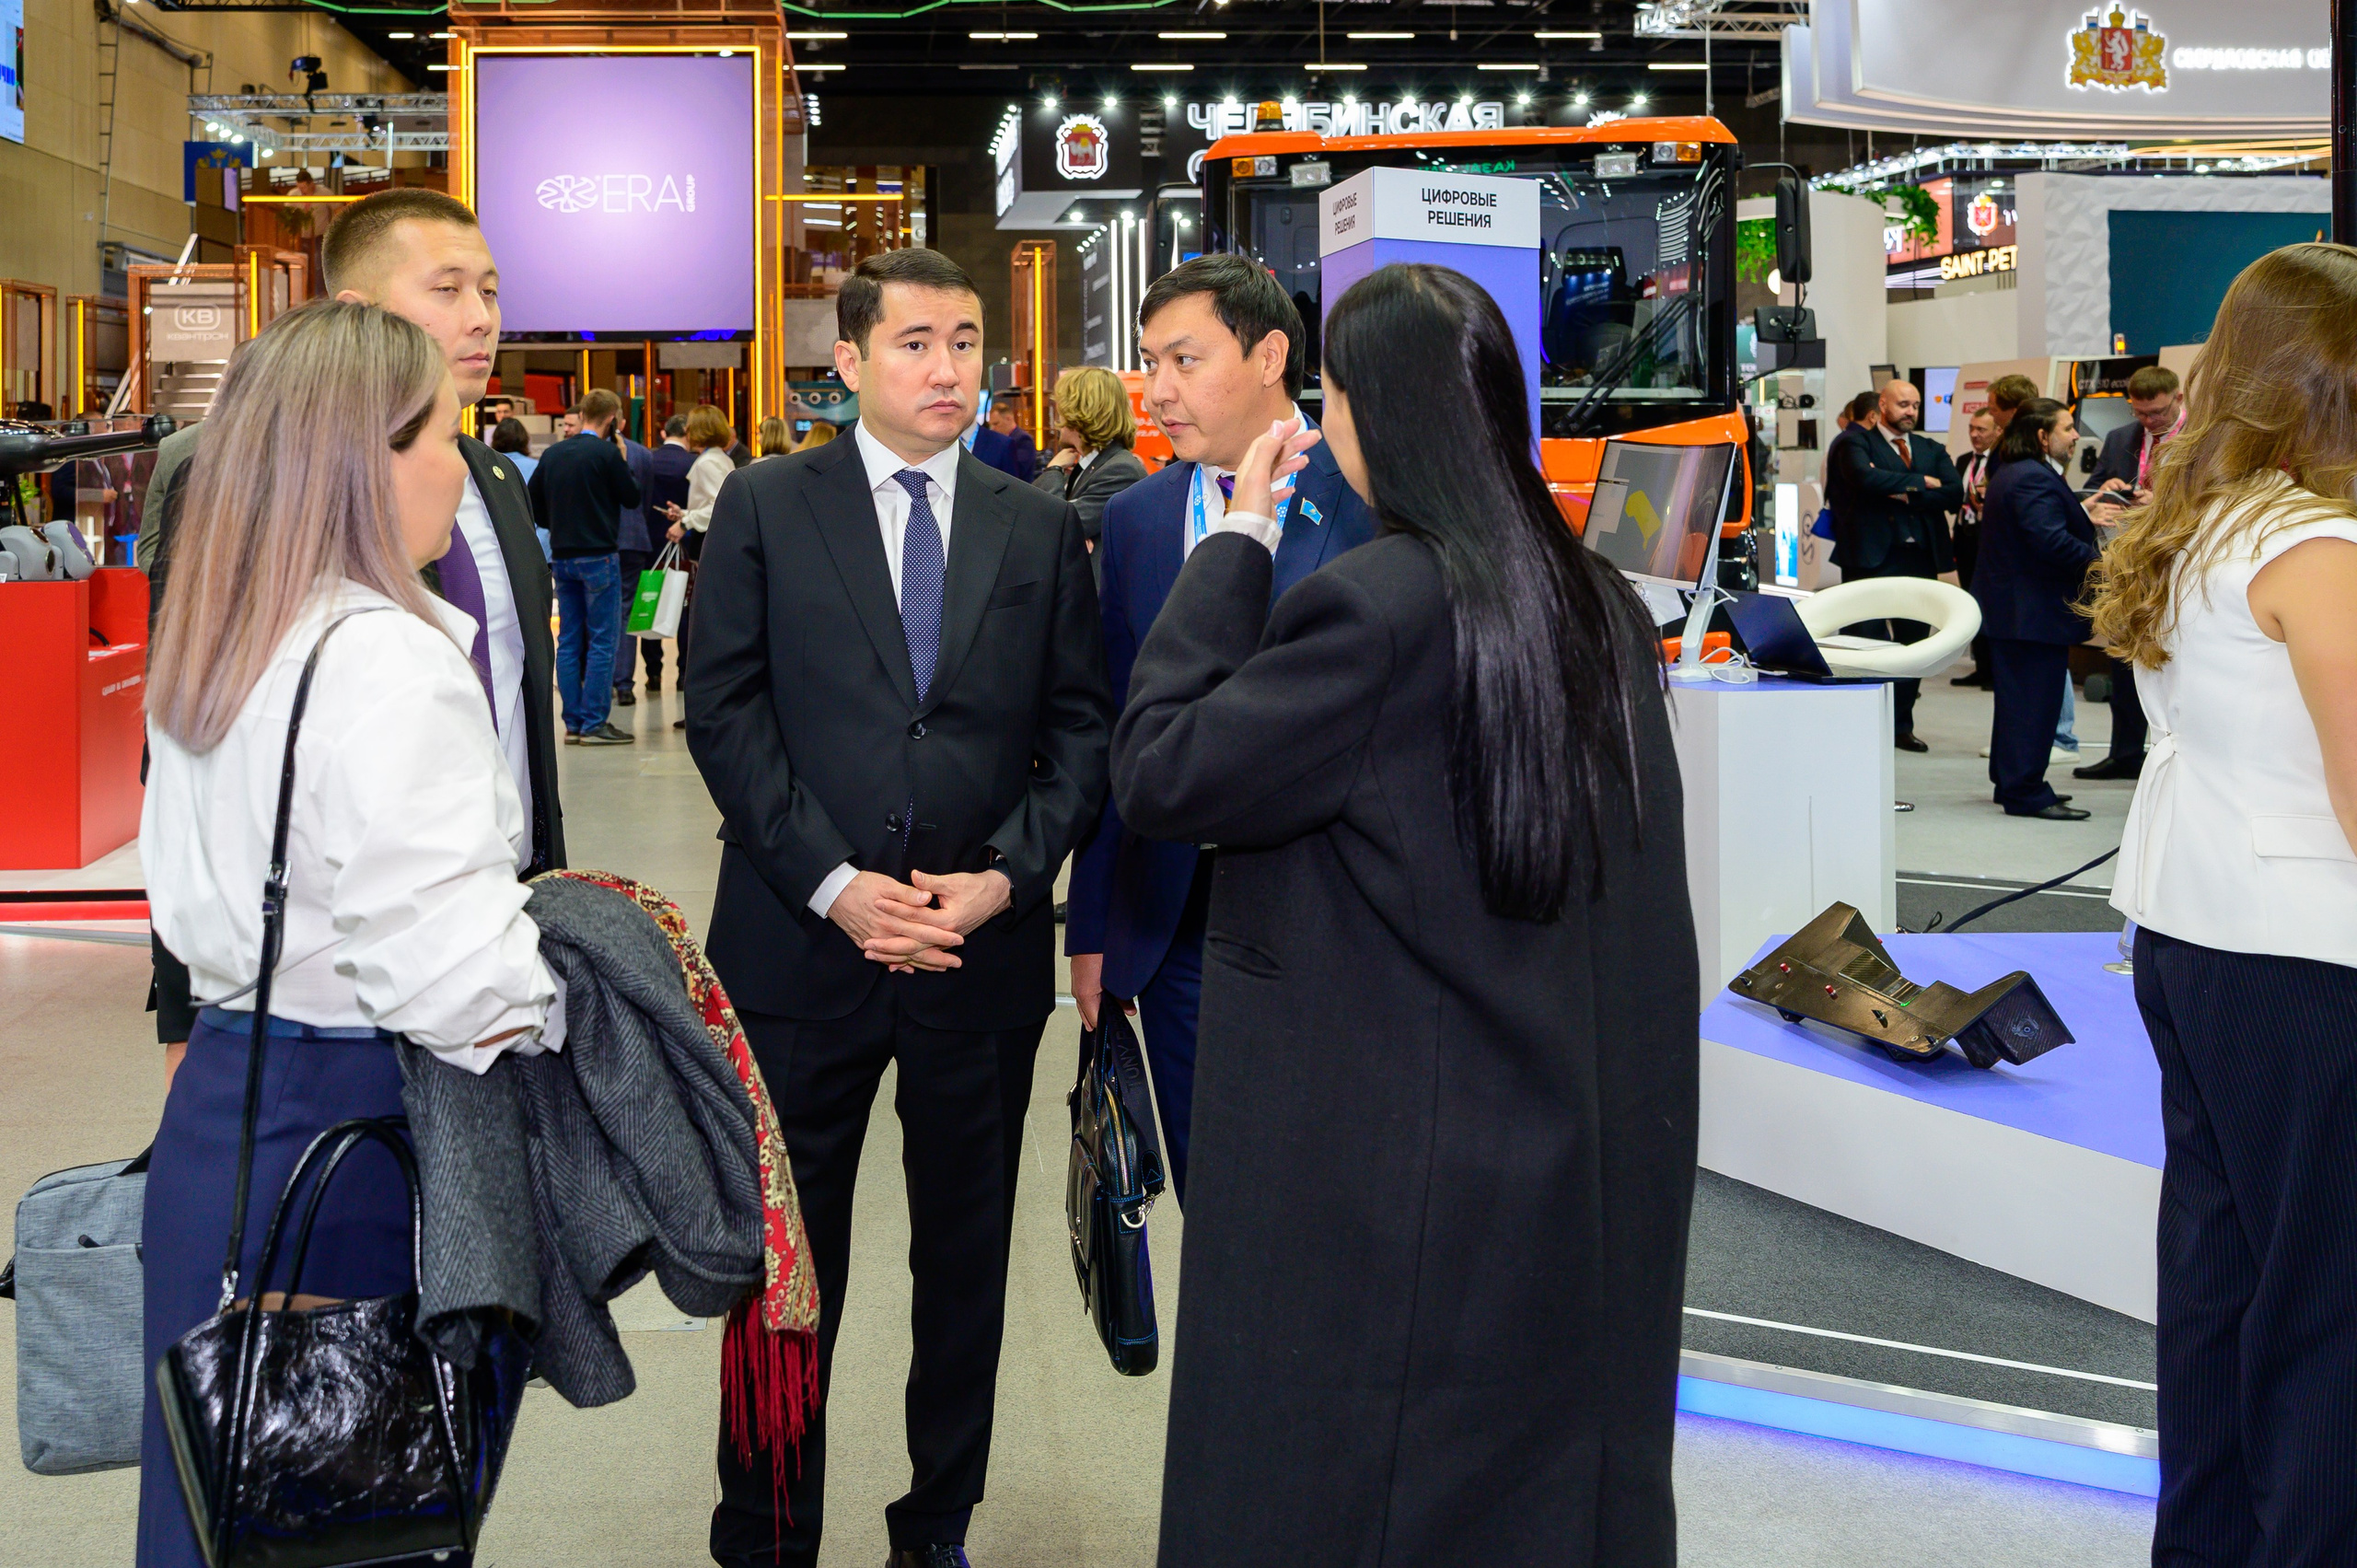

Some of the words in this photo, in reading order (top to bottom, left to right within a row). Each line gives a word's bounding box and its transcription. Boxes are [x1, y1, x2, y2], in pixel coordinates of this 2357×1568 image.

[603, 174, 685, 213] ERA
[685, 173, 696, 213] GROUP
[1332, 192, 1357, 217] ЦИФРОВЫЕ
[1421, 187, 1498, 208] ЦИФРОВЫЕ
[1334, 214, 1356, 237] РЕШЕНИЯ
[1427, 209, 1492, 229] РЕШЕНИЯ
[1940, 250, 1986, 280] SAINT
[181, 308, 215, 325] КВ
